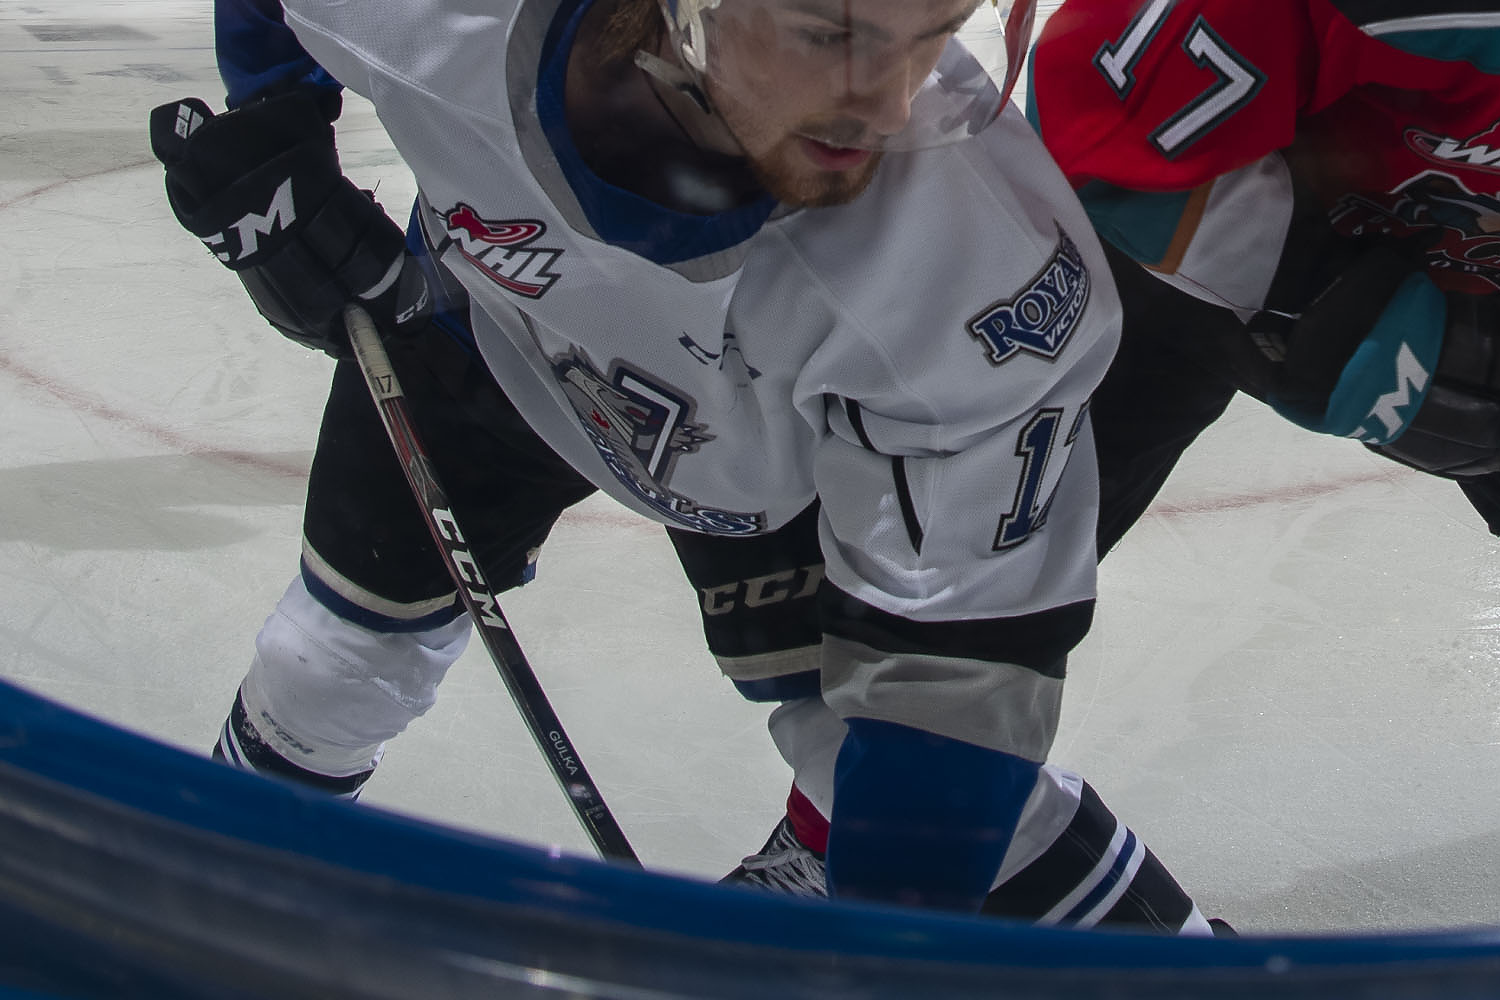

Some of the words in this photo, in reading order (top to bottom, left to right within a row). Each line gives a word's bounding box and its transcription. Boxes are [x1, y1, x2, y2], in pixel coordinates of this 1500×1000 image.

[374, 375, 394, 395] 17
[432, 504, 510, 632] CCM
[548, 729, 579, 777] GULKA
